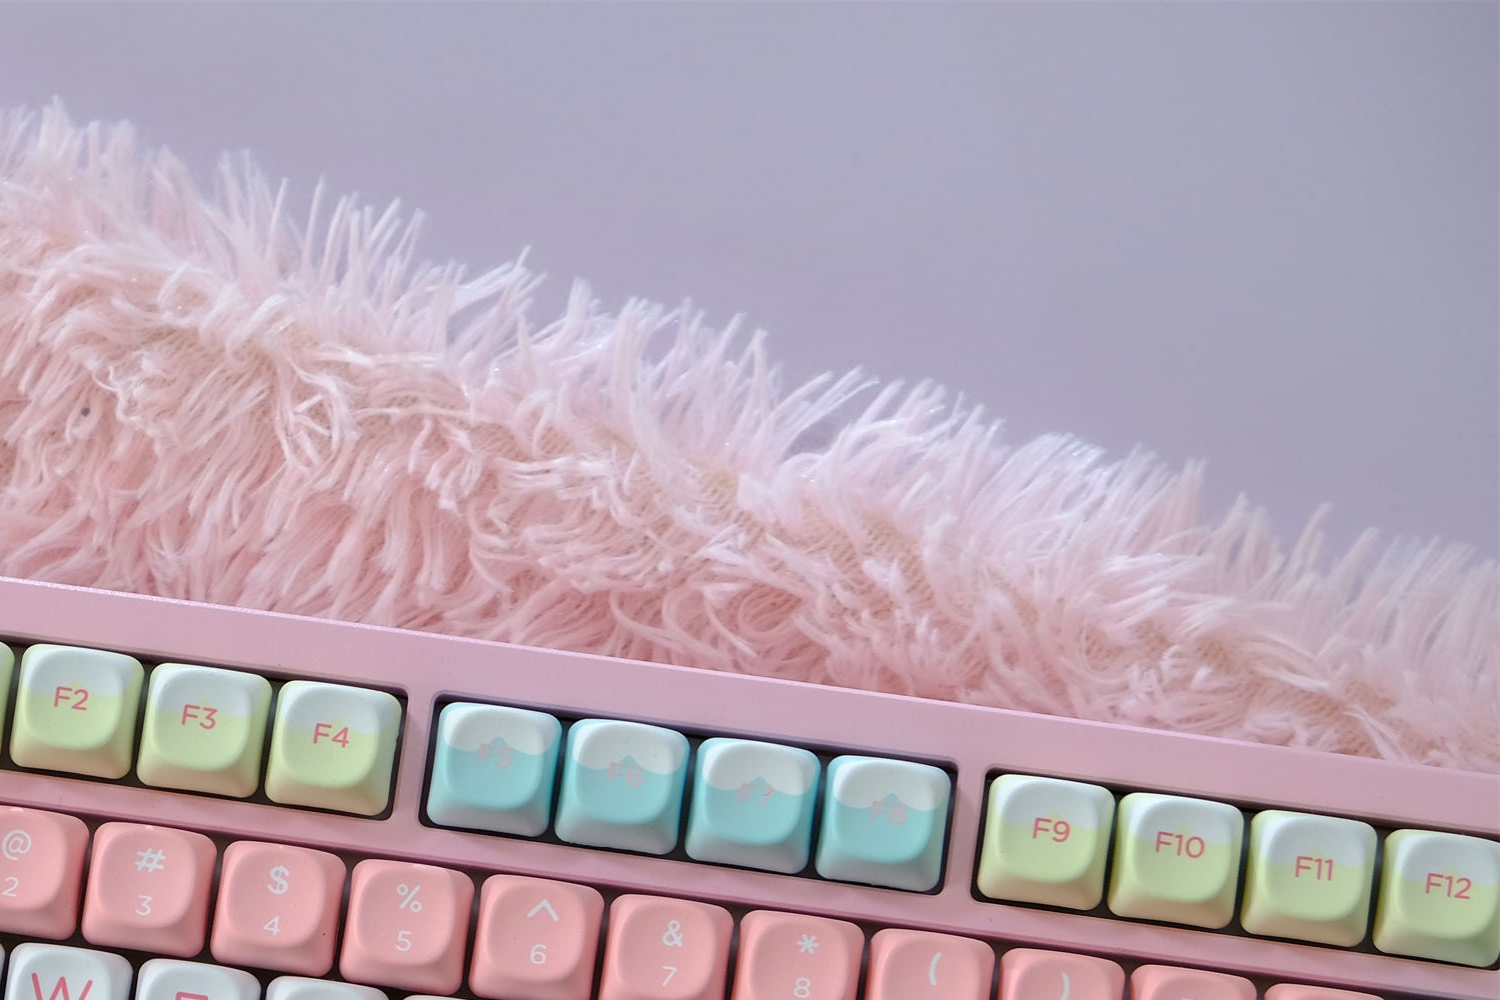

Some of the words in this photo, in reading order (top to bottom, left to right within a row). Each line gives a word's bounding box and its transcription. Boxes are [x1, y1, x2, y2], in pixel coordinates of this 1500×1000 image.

[53, 685, 90, 712] F2
[181, 703, 218, 731] F3
[312, 721, 350, 748] F4
[477, 742, 514, 769] F5
[606, 760, 645, 789] F6
[737, 782, 775, 808] F7
[869, 800, 908, 826] F8
[1032, 816, 1072, 843] F9
[1, 829, 33, 861] @
[1155, 830, 1206, 859] F10
[135, 847, 167, 873] #
[1294, 854, 1335, 881] F11
[1, 876, 20, 898] 2
[267, 864, 291, 895] $
[1425, 871, 1473, 901] F12
[135, 895, 153, 916] 3
[396, 883, 424, 913] %
[262, 915, 281, 936] 4
[661, 919, 684, 948] &
[395, 929, 413, 952] 5
[529, 943, 548, 965] 6
[662, 965, 677, 987] 7
[793, 977, 812, 999] 8
